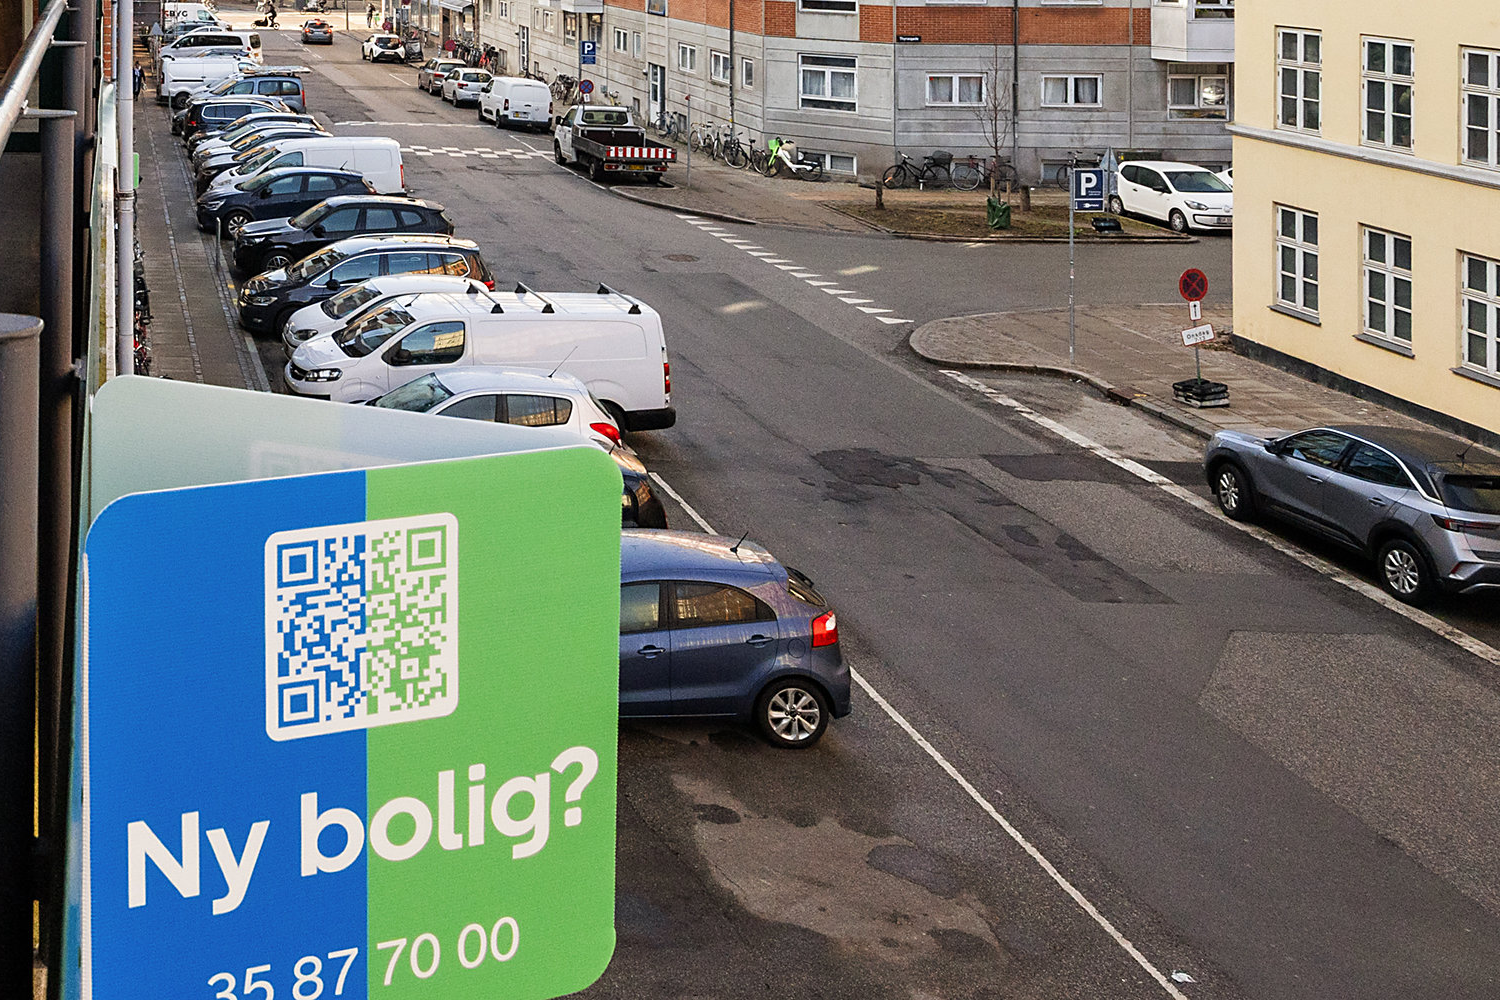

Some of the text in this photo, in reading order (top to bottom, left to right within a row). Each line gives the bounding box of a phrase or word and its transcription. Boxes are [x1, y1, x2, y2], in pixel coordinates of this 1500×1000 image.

[584, 42, 594, 54] P
[1080, 172, 1098, 196] P
[127, 746, 599, 916] Ny bolig?
[207, 916, 520, 1000] 35 87 70 00
